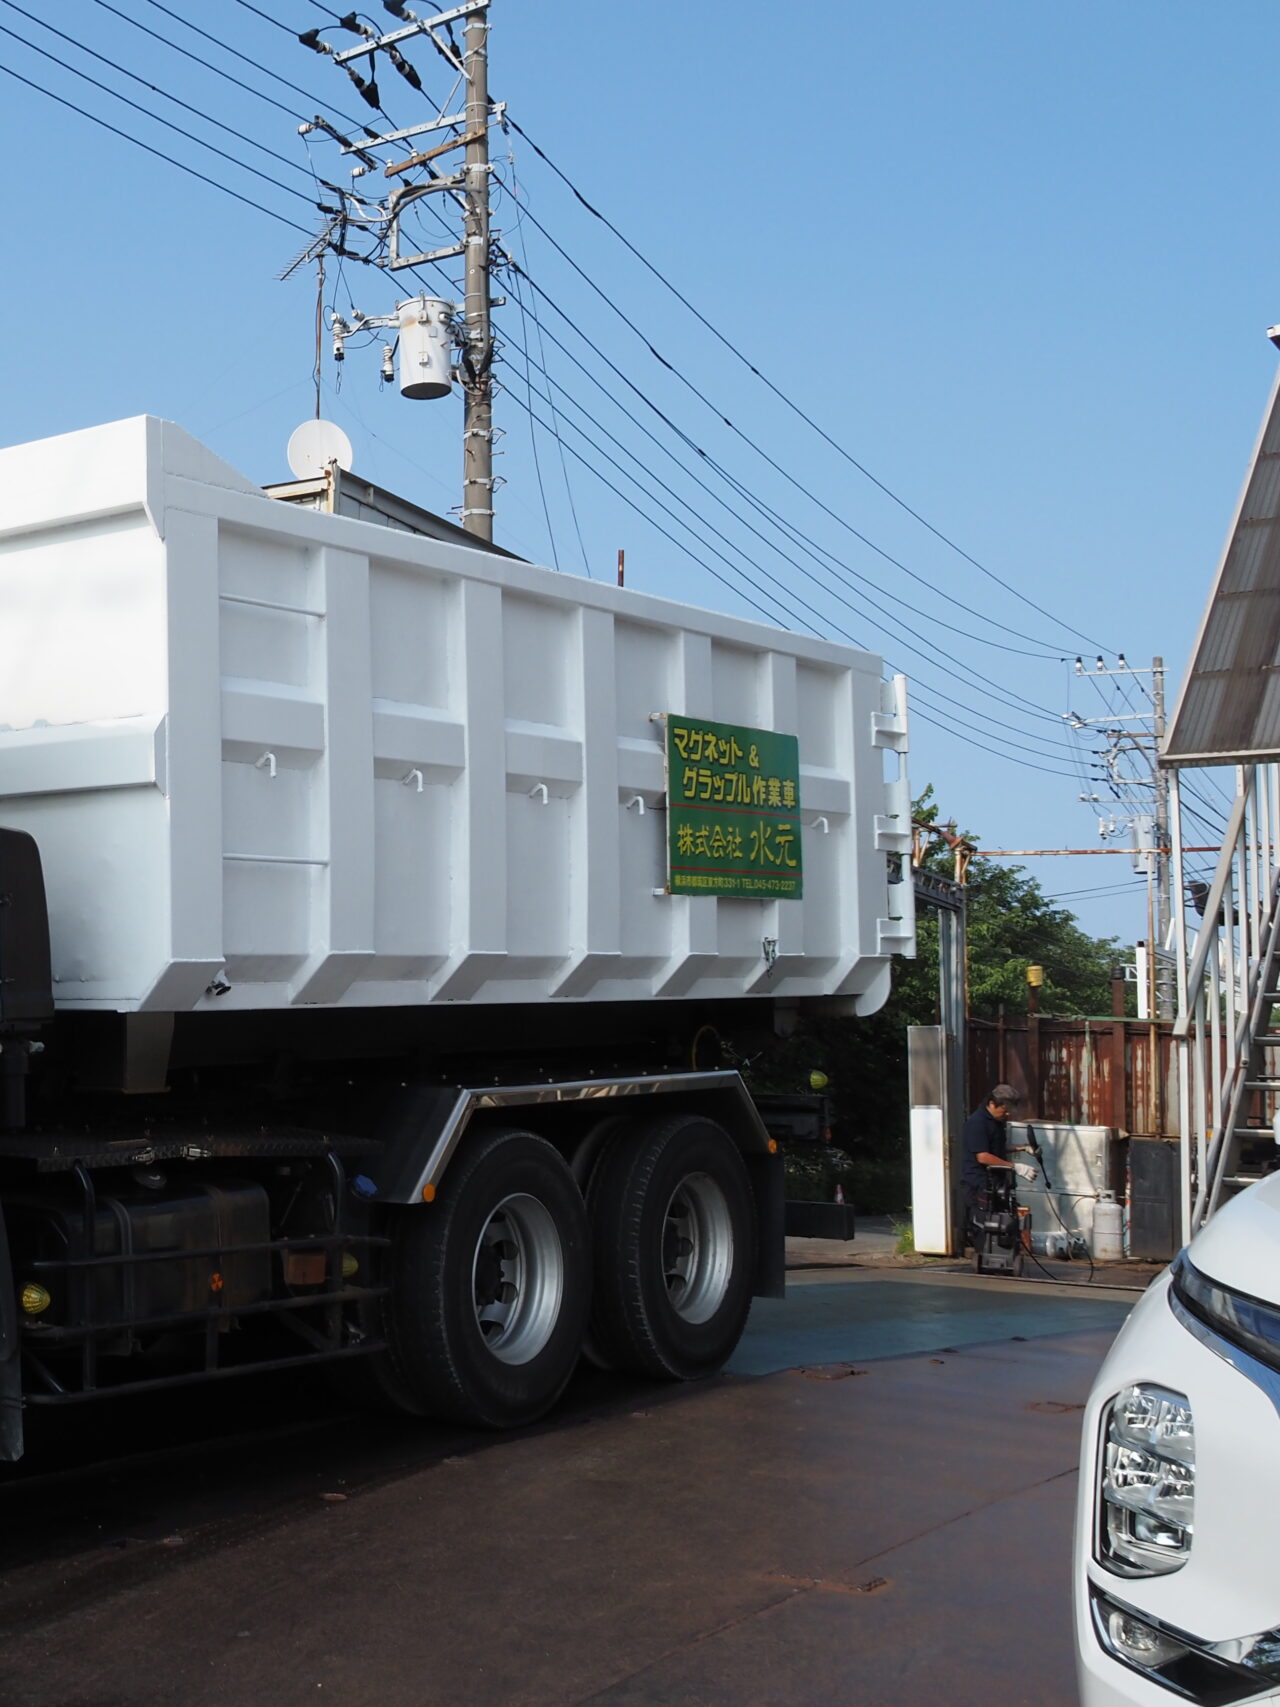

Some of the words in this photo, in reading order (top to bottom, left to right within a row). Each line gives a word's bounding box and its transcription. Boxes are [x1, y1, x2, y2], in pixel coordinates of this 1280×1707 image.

[673, 727, 744, 766] マグネット
[748, 744, 760, 768] &
[682, 766, 796, 808] グラップル作業車
[677, 823, 743, 859] 株式会社
[750, 820, 797, 867] 水元
